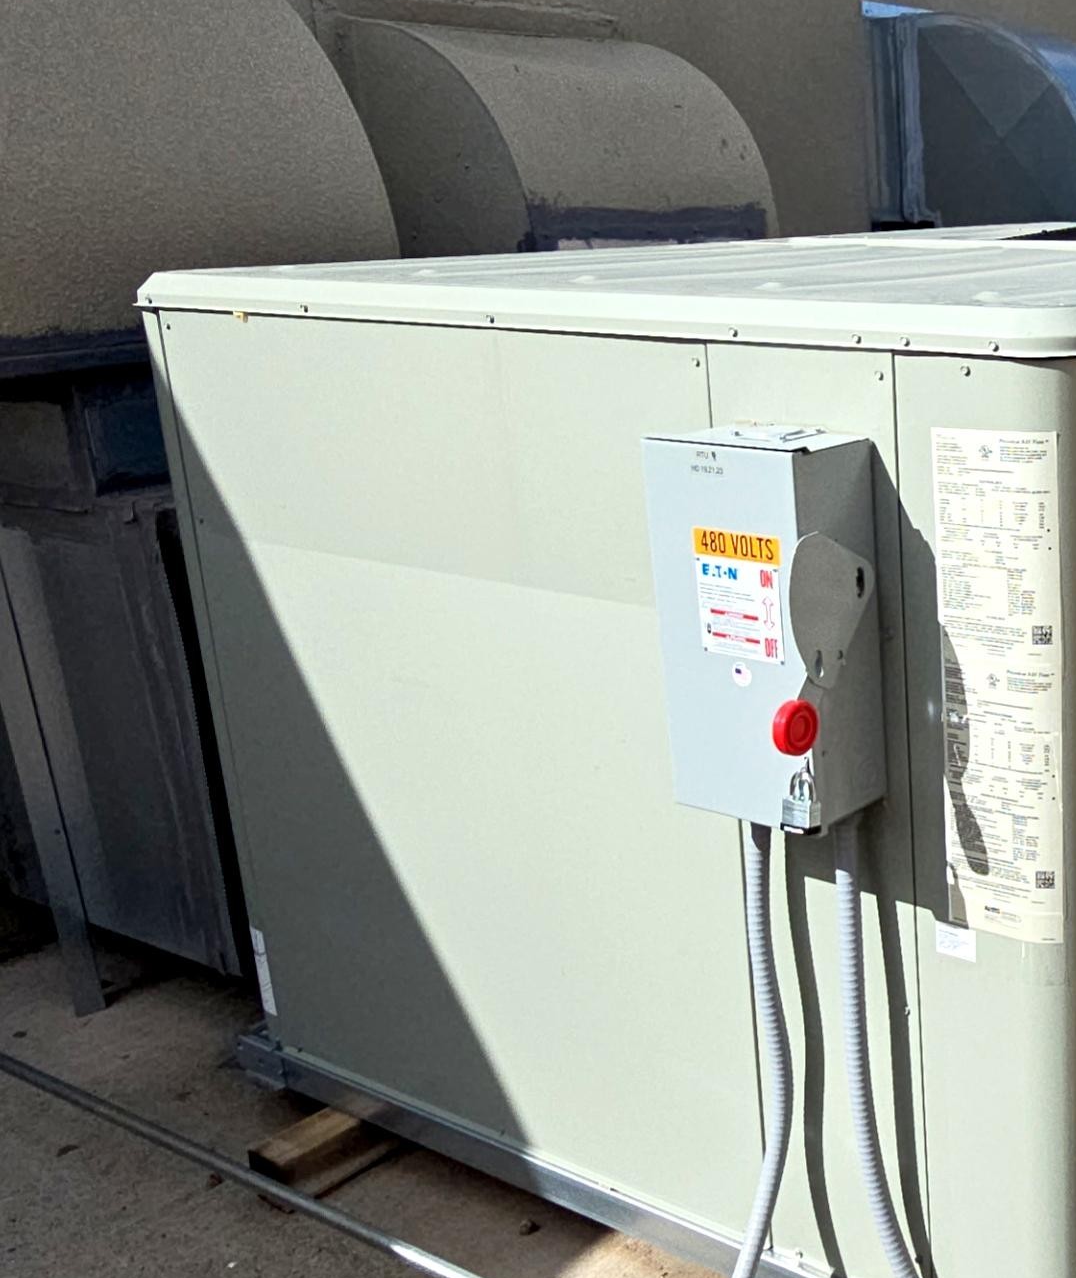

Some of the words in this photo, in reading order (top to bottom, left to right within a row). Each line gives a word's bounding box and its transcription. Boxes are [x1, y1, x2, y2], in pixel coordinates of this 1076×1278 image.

[701, 530, 726, 554] 480
[730, 533, 774, 561] VOLTS
[760, 569, 773, 589] ON
[764, 637, 778, 660] OFF
